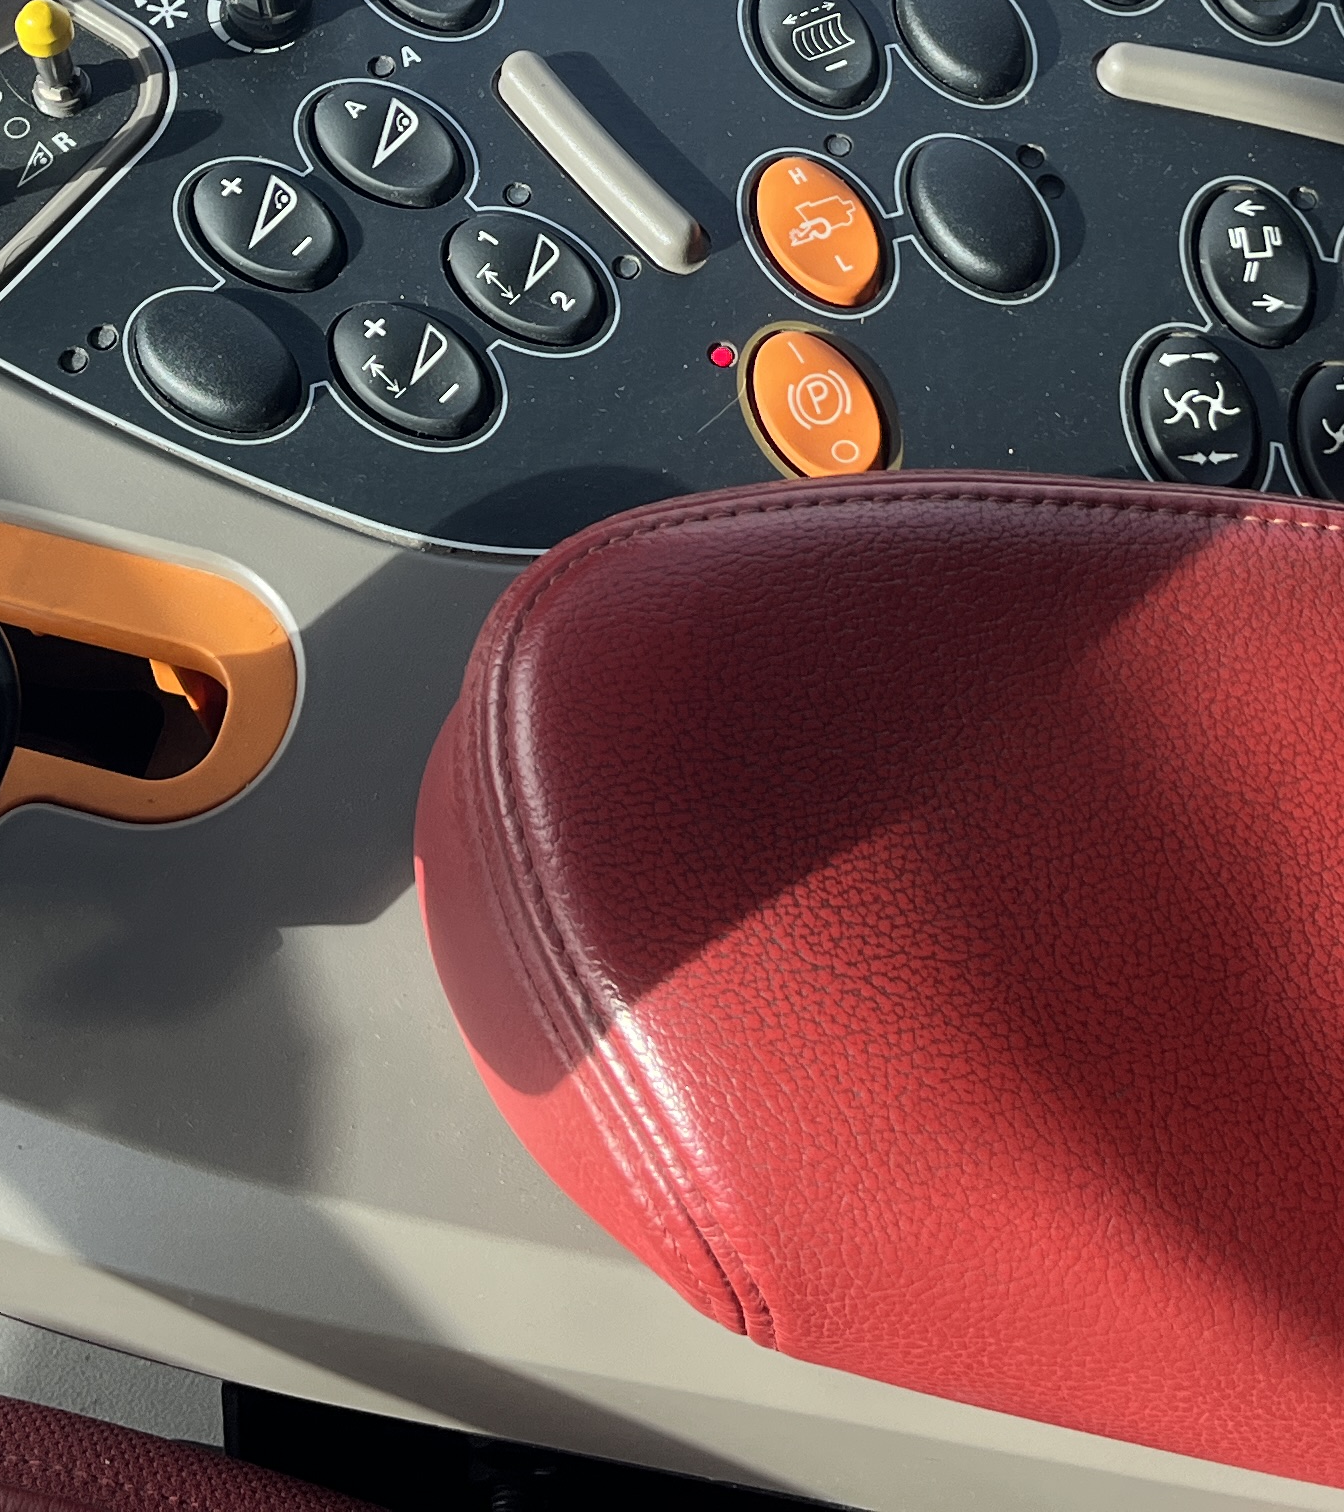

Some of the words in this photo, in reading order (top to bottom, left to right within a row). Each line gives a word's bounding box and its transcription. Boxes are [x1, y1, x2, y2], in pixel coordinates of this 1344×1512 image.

[400, 46, 422, 68] A
[345, 100, 367, 118] A
[52, 130, 76, 153] R
[787, 168, 808, 185] H
[478, 230, 499, 245] 1
[835, 254, 854, 272] L
[550, 291, 576, 312] 2
